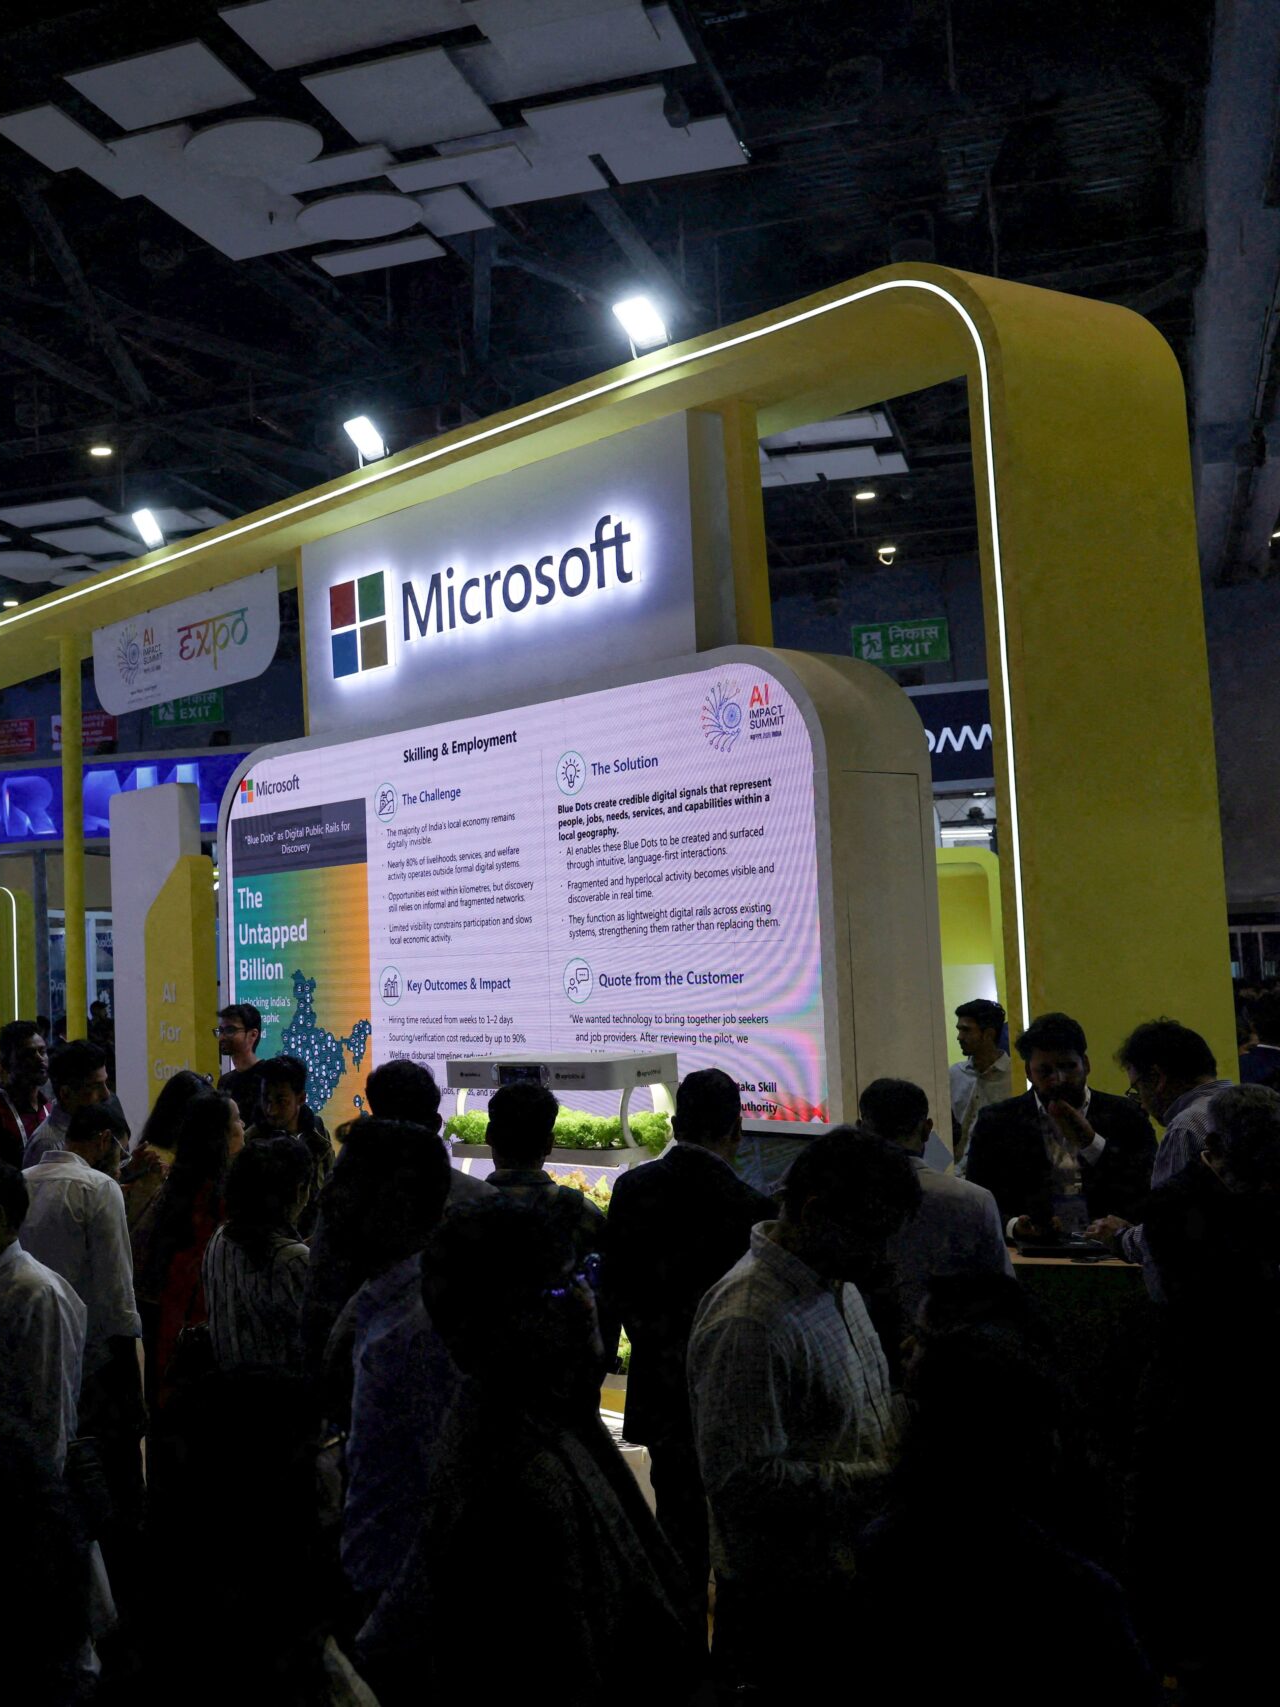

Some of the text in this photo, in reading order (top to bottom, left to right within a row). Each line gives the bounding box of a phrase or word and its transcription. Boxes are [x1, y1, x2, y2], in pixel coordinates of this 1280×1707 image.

[402, 514, 632, 641] Microsoft
[143, 628, 154, 646] AI
[888, 626, 939, 642] निकास
[143, 644, 161, 656] IMPACT
[890, 642, 932, 658] EXIT
[750, 683, 769, 707] AI
[180, 706, 211, 719] EXIT
[749, 705, 783, 719] IMPACT
[750, 715, 785, 729] SUMMIT
[403, 730, 516, 763] Skilling & Employment
[591, 755, 658, 775] The Solution
[256, 774, 299, 797] Microsoft
[402, 788, 461, 805] The Challenge
[557, 777, 771, 814] Blue Dots create credible digital signals that represent
[558, 793, 770, 828] people, jobs, needs, services, and capabilities within a
[558, 826, 619, 841] local geography.
[281, 843, 310, 854] Discovery
[237, 887, 262, 909] The
[239, 918, 307, 949] Untapped
[569, 917, 780, 939] systems, strengthening them rather than replacing them.
[240, 958, 283, 980] Billion
[407, 977, 510, 994] Key Outcomes & Impact
[599, 971, 744, 988] Quote from the Customer
[162, 982, 177, 1003] AI
[388, 1016, 405, 1026] Hiring
[419, 1015, 442, 1024] reduced
[444, 1014, 458, 1024] from
[459, 1015, 477, 1024] weeks
[478, 1016, 485, 1024] to
[498, 1015, 513, 1026] days
[585, 1014, 610, 1023] wanted
[612, 1014, 652, 1026] technology
[654, 1015, 662, 1023] to
[664, 1013, 685, 1026] bring
[687, 1013, 721, 1026] together
[722, 1013, 736, 1026] job
[738, 1013, 768, 1024] seekers
[160, 1022, 181, 1041] For
[389, 1032, 445, 1044] Sourcing/verification
[446, 1034, 458, 1042] cost
[459, 1033, 483, 1042] reduced
[484, 1033, 492, 1045] by
[494, 1035, 502, 1045] up
[512, 1033, 526, 1043] 90%
[575, 1032, 748, 1045] and job providers. After reviewing the pilot, we
[758, 1082, 777, 1093] Skill
[741, 1101, 778, 1115] uthority
